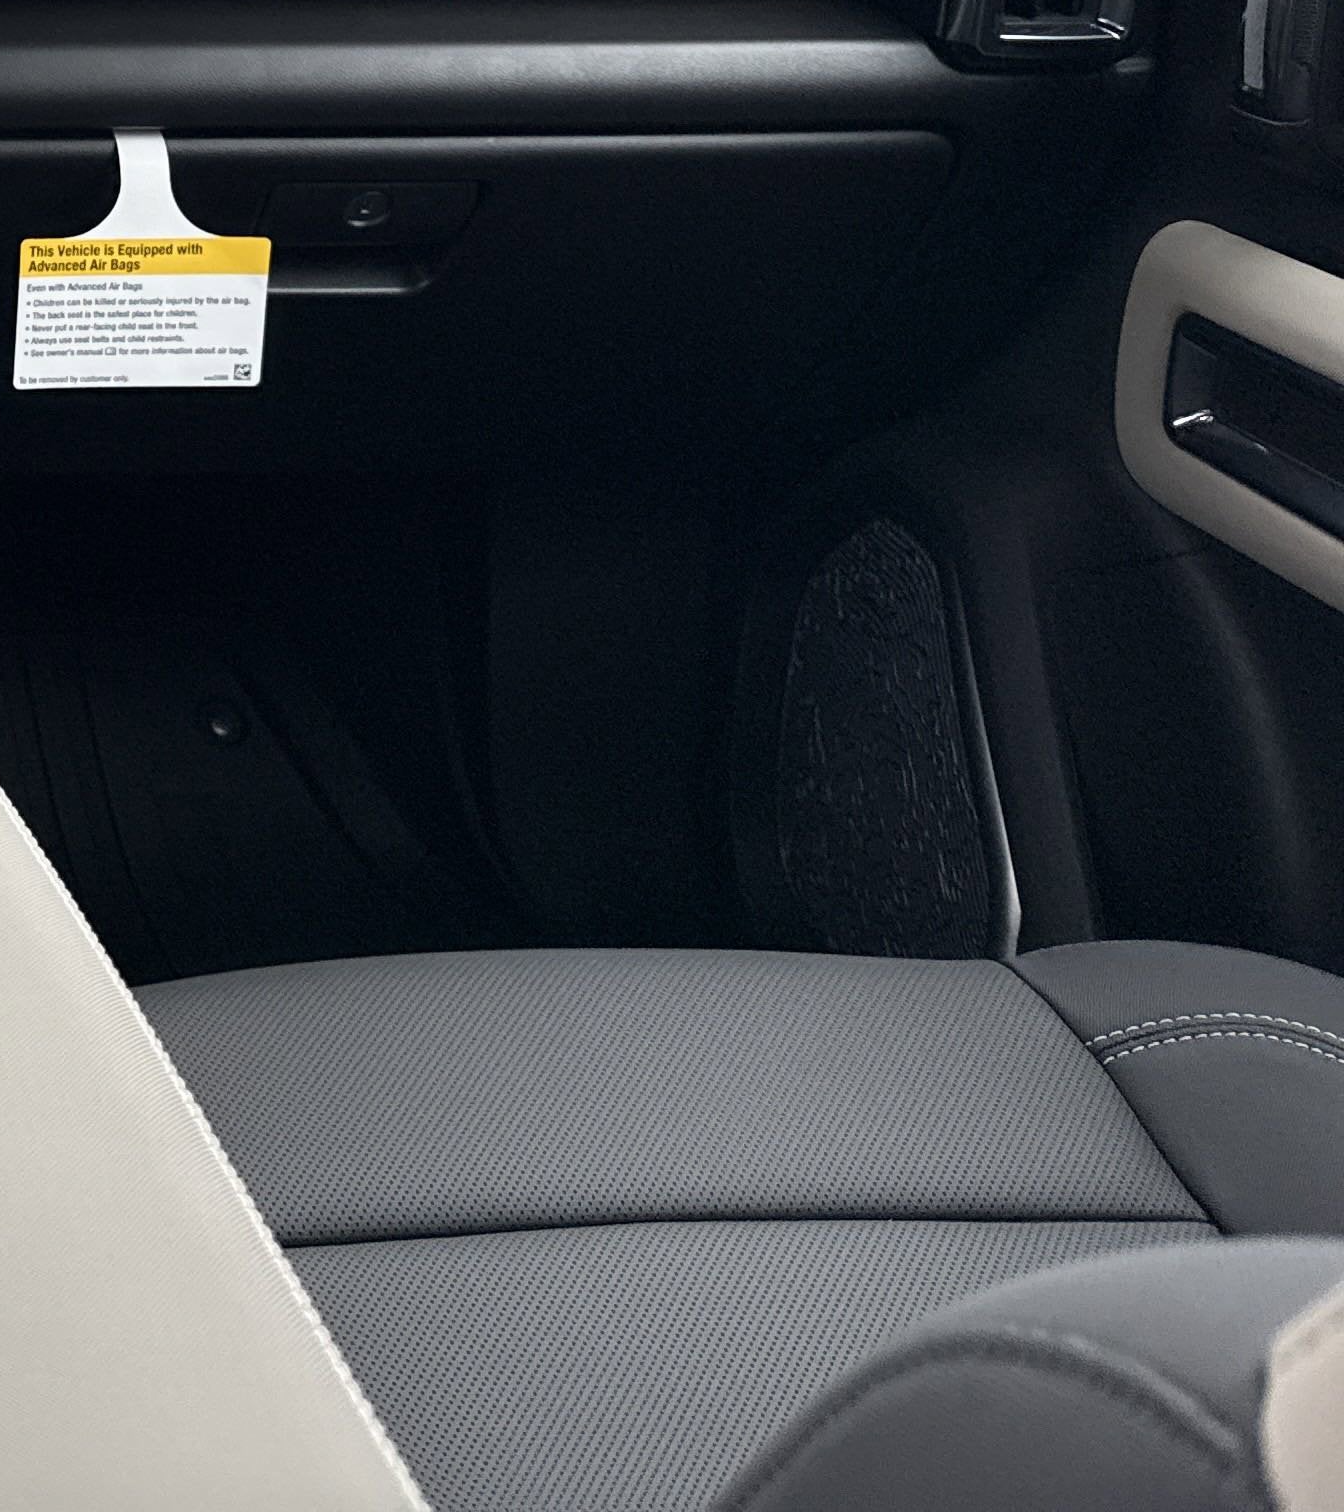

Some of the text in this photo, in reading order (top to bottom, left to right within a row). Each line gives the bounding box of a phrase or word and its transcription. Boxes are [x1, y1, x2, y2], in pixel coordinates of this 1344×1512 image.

[29, 243, 203, 257] This Vehicle is Equipped with
[28, 259, 140, 272] Advanced Air Bags
[27, 282, 143, 293] Even with Advanced Air Bags
[33, 299, 64, 307] Children
[129, 298, 162, 306] seriously
[195, 297, 204, 306] by
[207, 296, 219, 304] the
